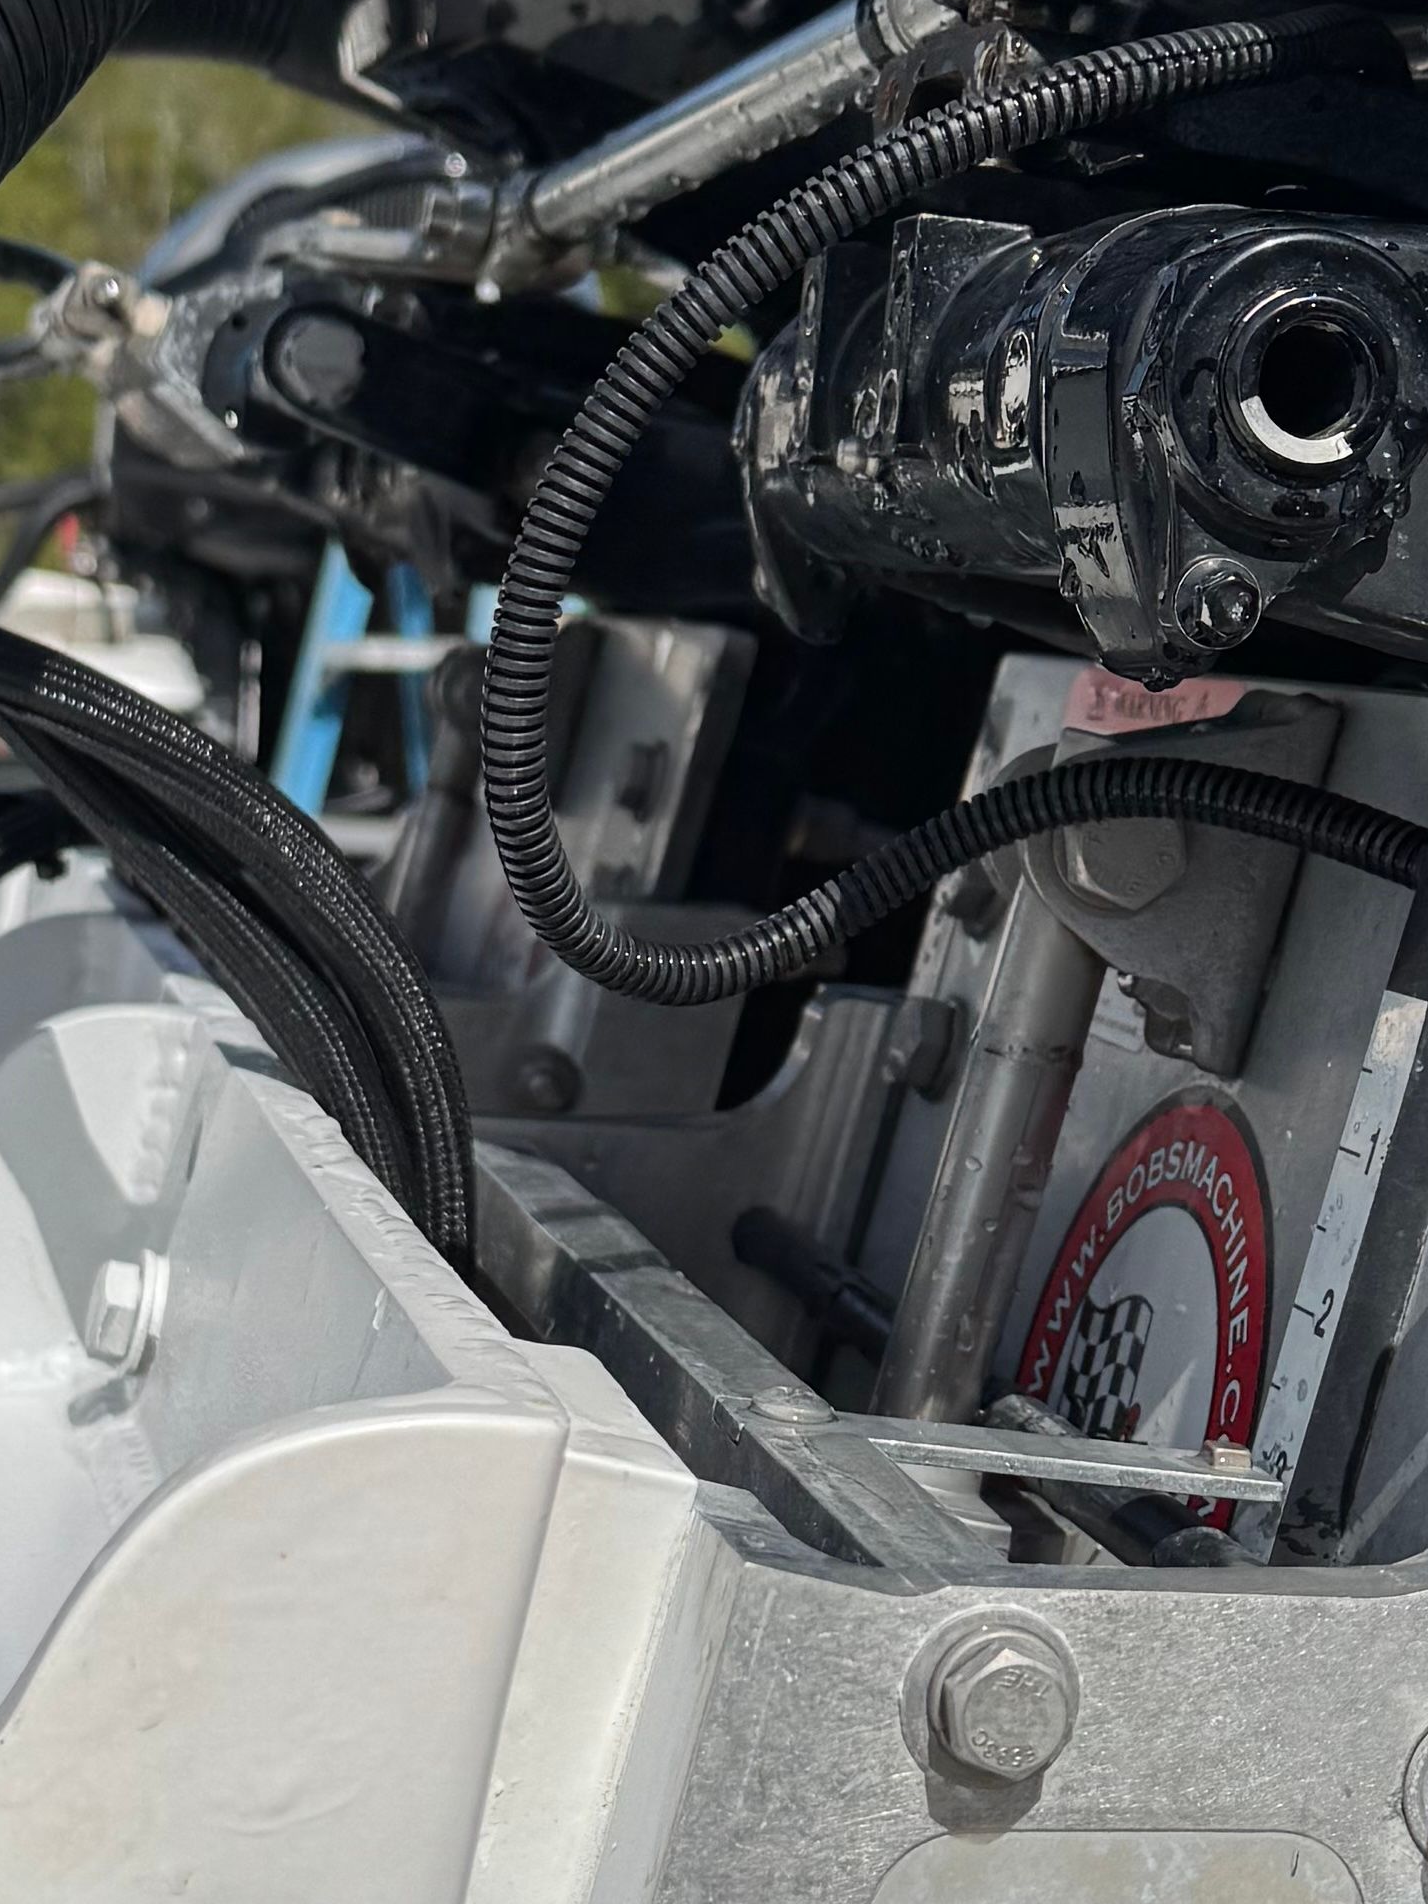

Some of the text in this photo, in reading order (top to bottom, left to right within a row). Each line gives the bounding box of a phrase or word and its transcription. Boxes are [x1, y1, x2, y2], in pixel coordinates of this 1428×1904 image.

[1365, 1127, 1382, 1175] 1
[1027, 1139, 1252, 1427] WWW.BOBSMACHINE.C
[1313, 1288, 1335, 1339] 2
